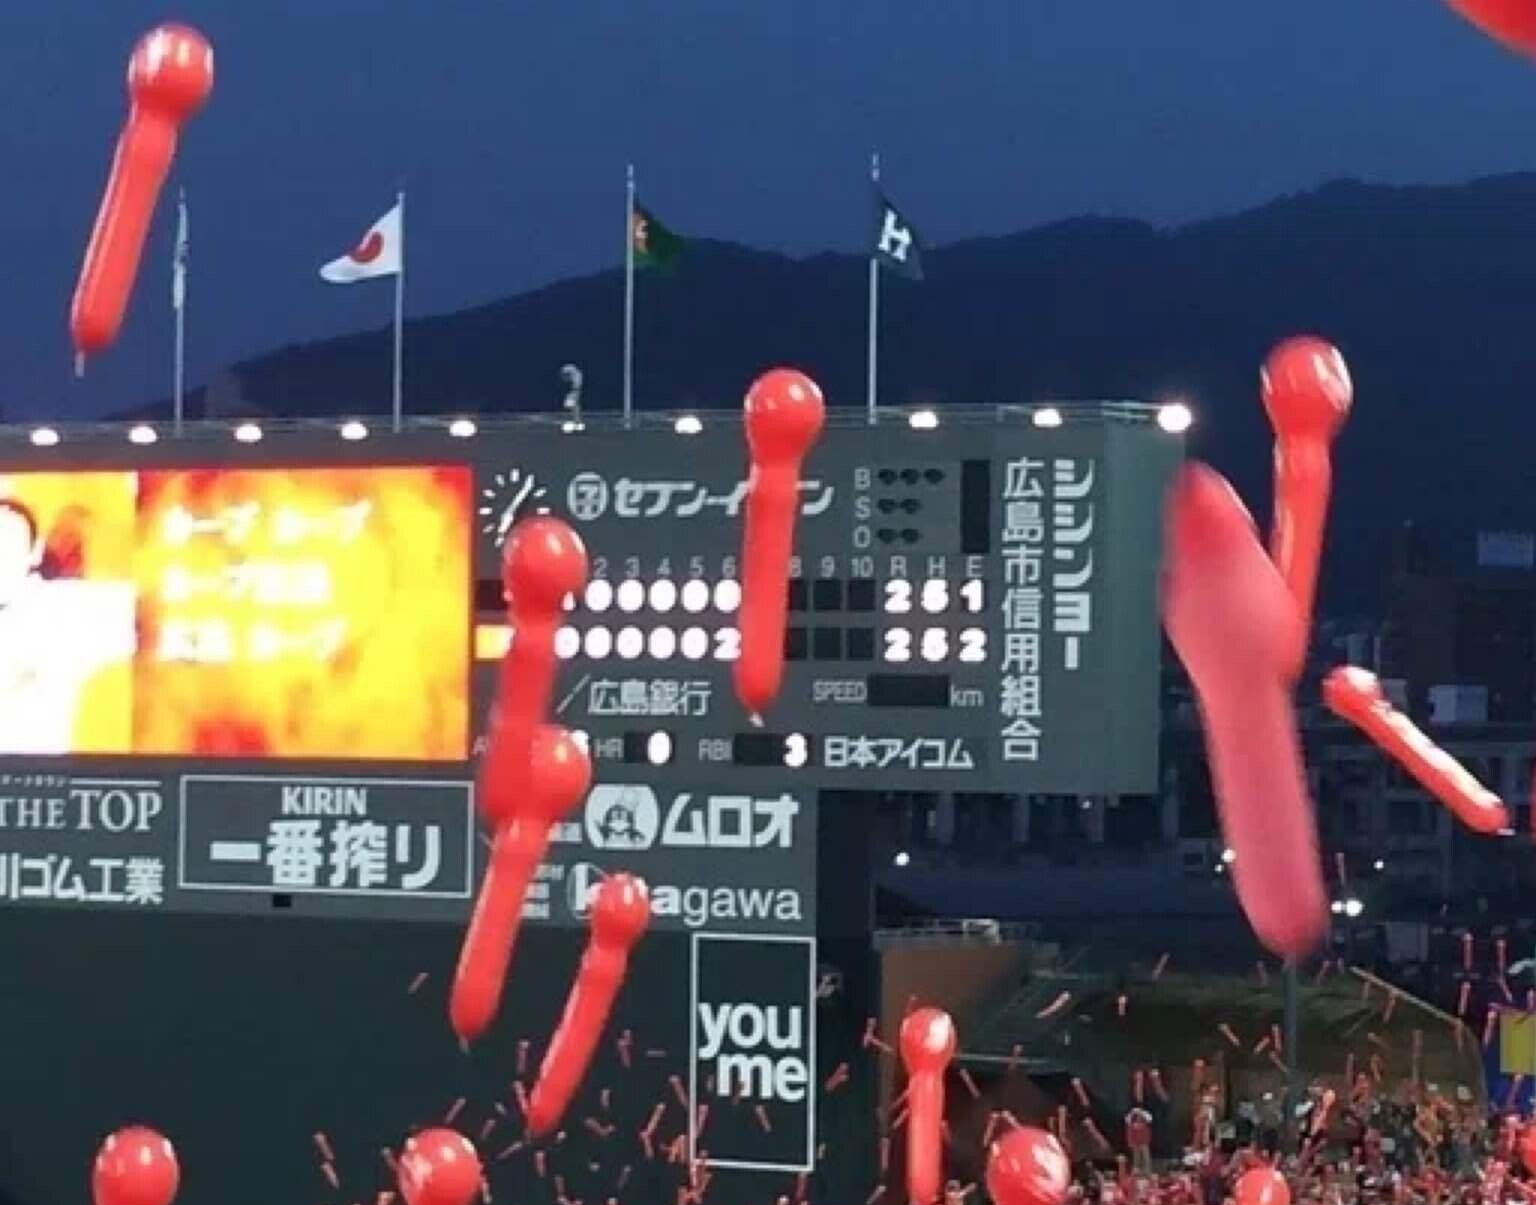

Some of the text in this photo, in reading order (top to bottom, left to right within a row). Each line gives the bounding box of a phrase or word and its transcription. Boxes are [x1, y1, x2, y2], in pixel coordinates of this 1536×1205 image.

[854, 467, 871, 491] B
[854, 496, 872, 520] S
[593, 556, 609, 578] 2
[625, 556, 642, 578] 3
[656, 556, 674, 578] 4
[690, 556, 706, 578] 5
[722, 557, 739, 579] 6
[820, 556, 837, 578] 9
[851, 556, 874, 578] 10
[890, 556, 907, 577] R
[928, 556, 947, 577] H
[966, 556, 984, 577] E
[1052, 458, 1094, 671] シシンヨー
[884, 579, 912, 613] 2
[960, 579, 984, 612] 1
[1000, 456, 1045, 762] 広島市信用組合
[714, 626, 742, 660] 2
[884, 627, 911, 662] 2
[959, 627, 987, 662] 2
[588, 677, 713, 716] 広島銀行
[814, 680, 866, 701] SPEED
[951, 684, 984, 707] km
[594, 738, 624, 759] HR
[648, 731, 673, 764] 0
[784, 732, 808, 768] 3
[824, 735, 976, 769] 日本アイコム
[70, 788, 162, 832] TOP
[282, 786, 367, 816] KIRIN
[663, 793, 799, 847] ムロオ
[209, 819, 443, 889] 一番搾り
[698, 1002, 803, 1061] you
[716, 1053, 809, 1103] me
